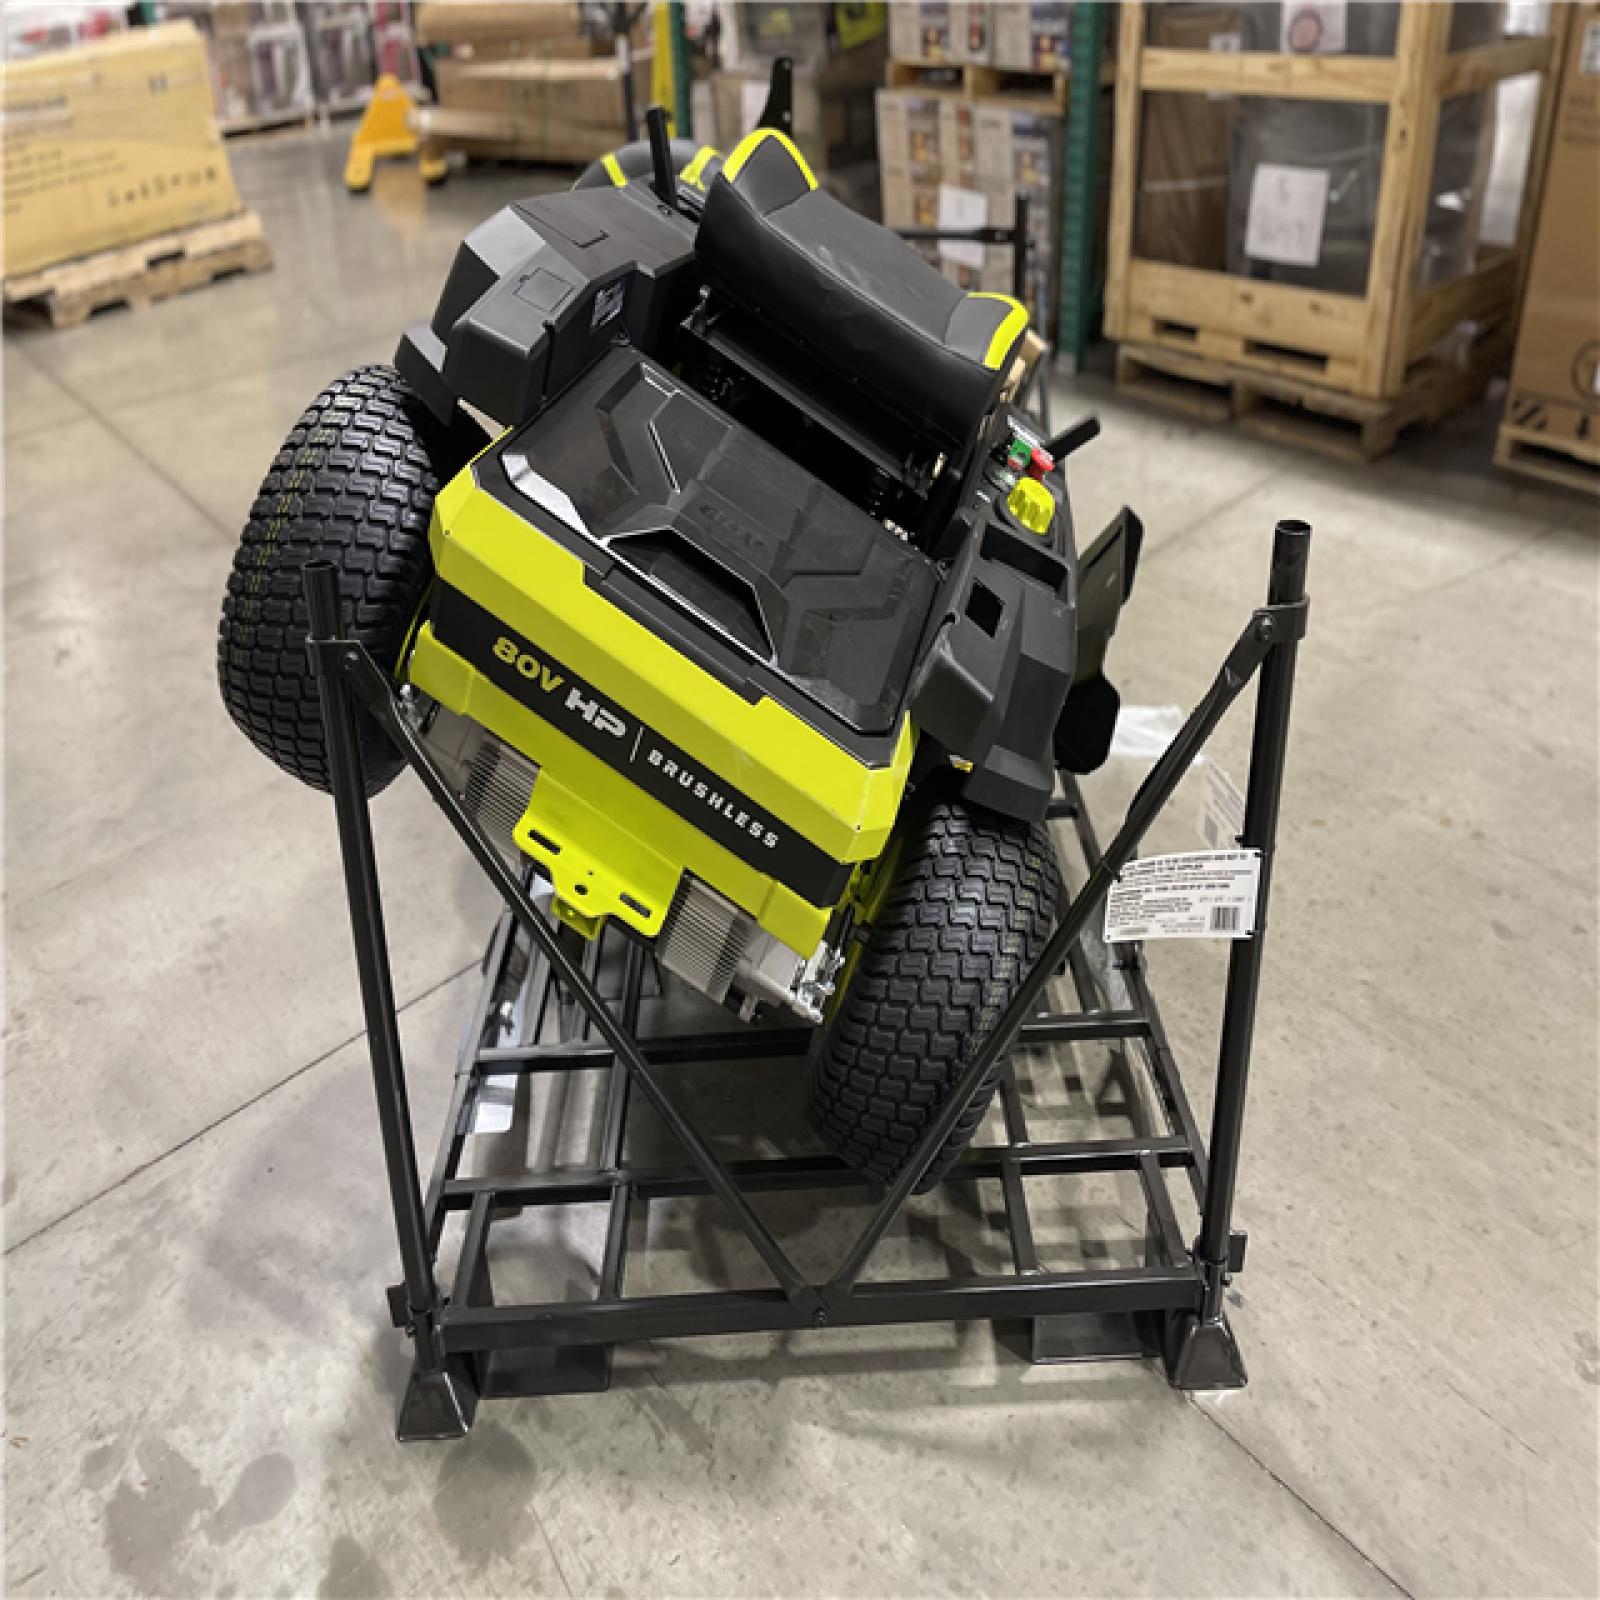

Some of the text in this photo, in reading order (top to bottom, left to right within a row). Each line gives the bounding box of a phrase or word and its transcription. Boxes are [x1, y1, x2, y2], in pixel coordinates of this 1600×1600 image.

[492, 637, 779, 848] 80V HP BRUSHLESS
